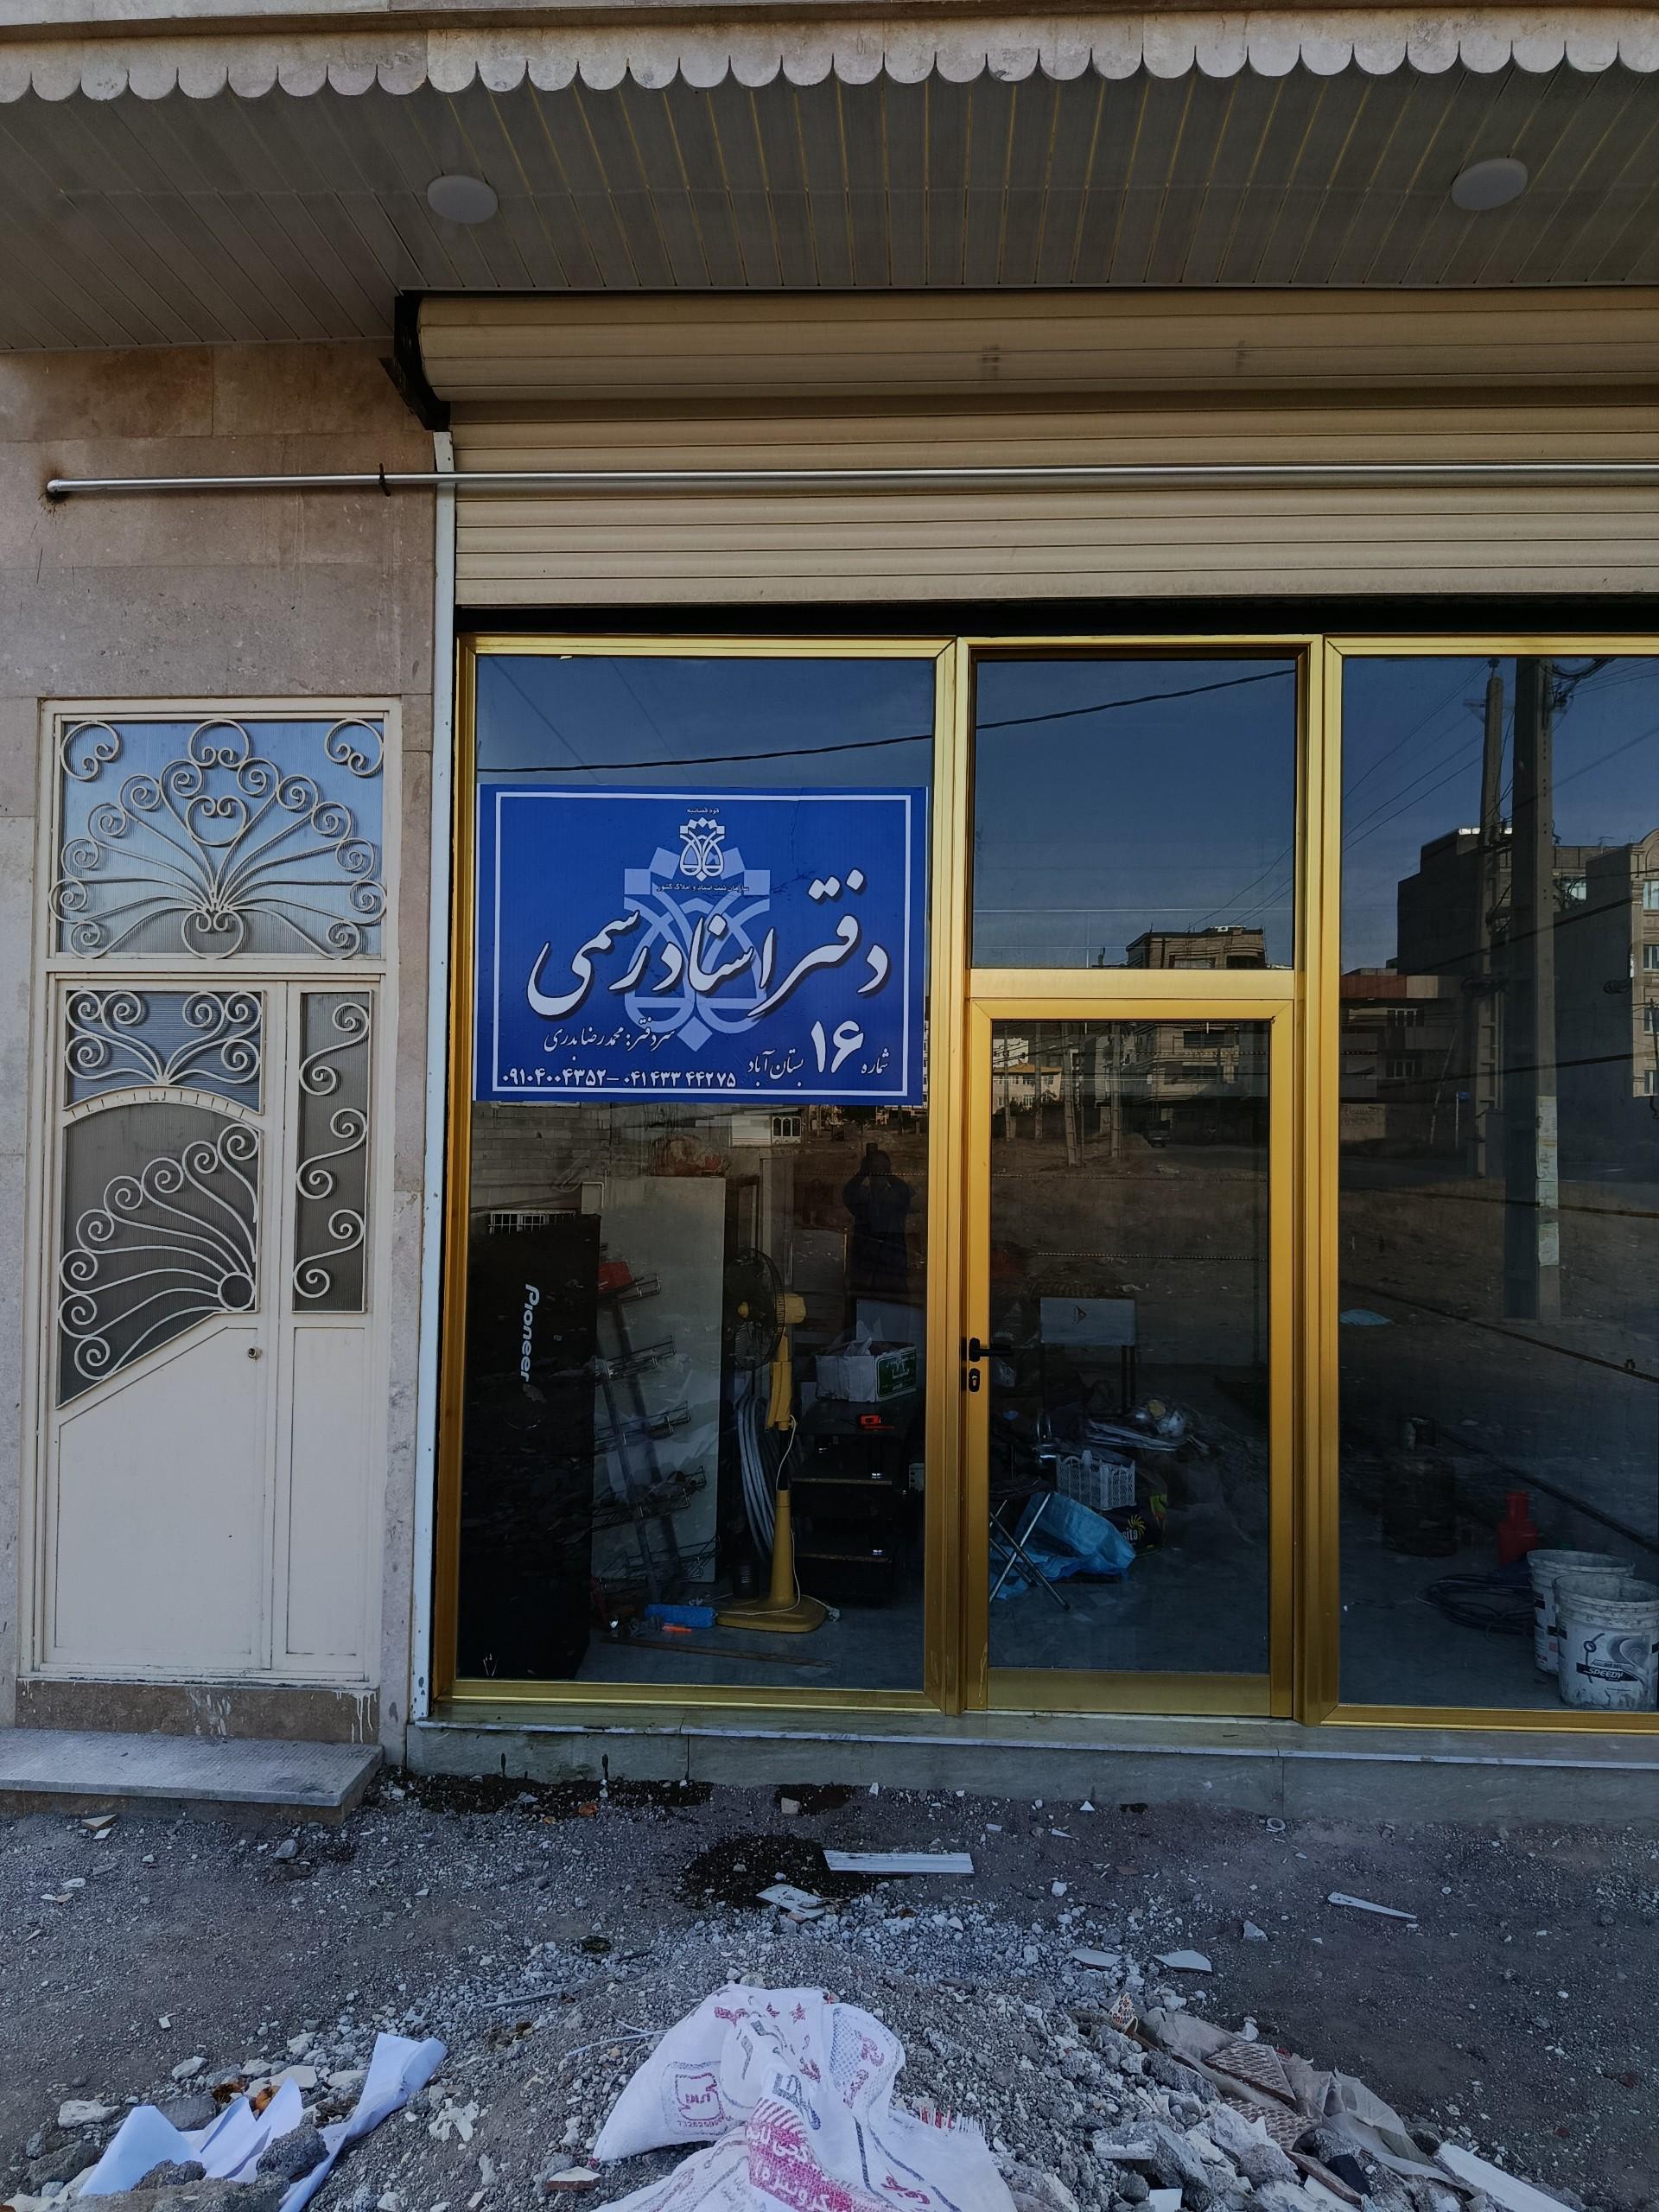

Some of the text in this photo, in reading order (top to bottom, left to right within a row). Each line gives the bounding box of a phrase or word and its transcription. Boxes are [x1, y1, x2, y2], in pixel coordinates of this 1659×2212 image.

[527, 868, 889, 1018] دفتر اسناد رسمی
[543, 1028, 578, 1061] بدری
[810, 1020, 864, 1074] ۱۶
[861, 1047, 890, 1074] شماره
[520, 1283, 540, 1382] Pioneer
[1588, 1667, 1624, 1679] SPEEDY
